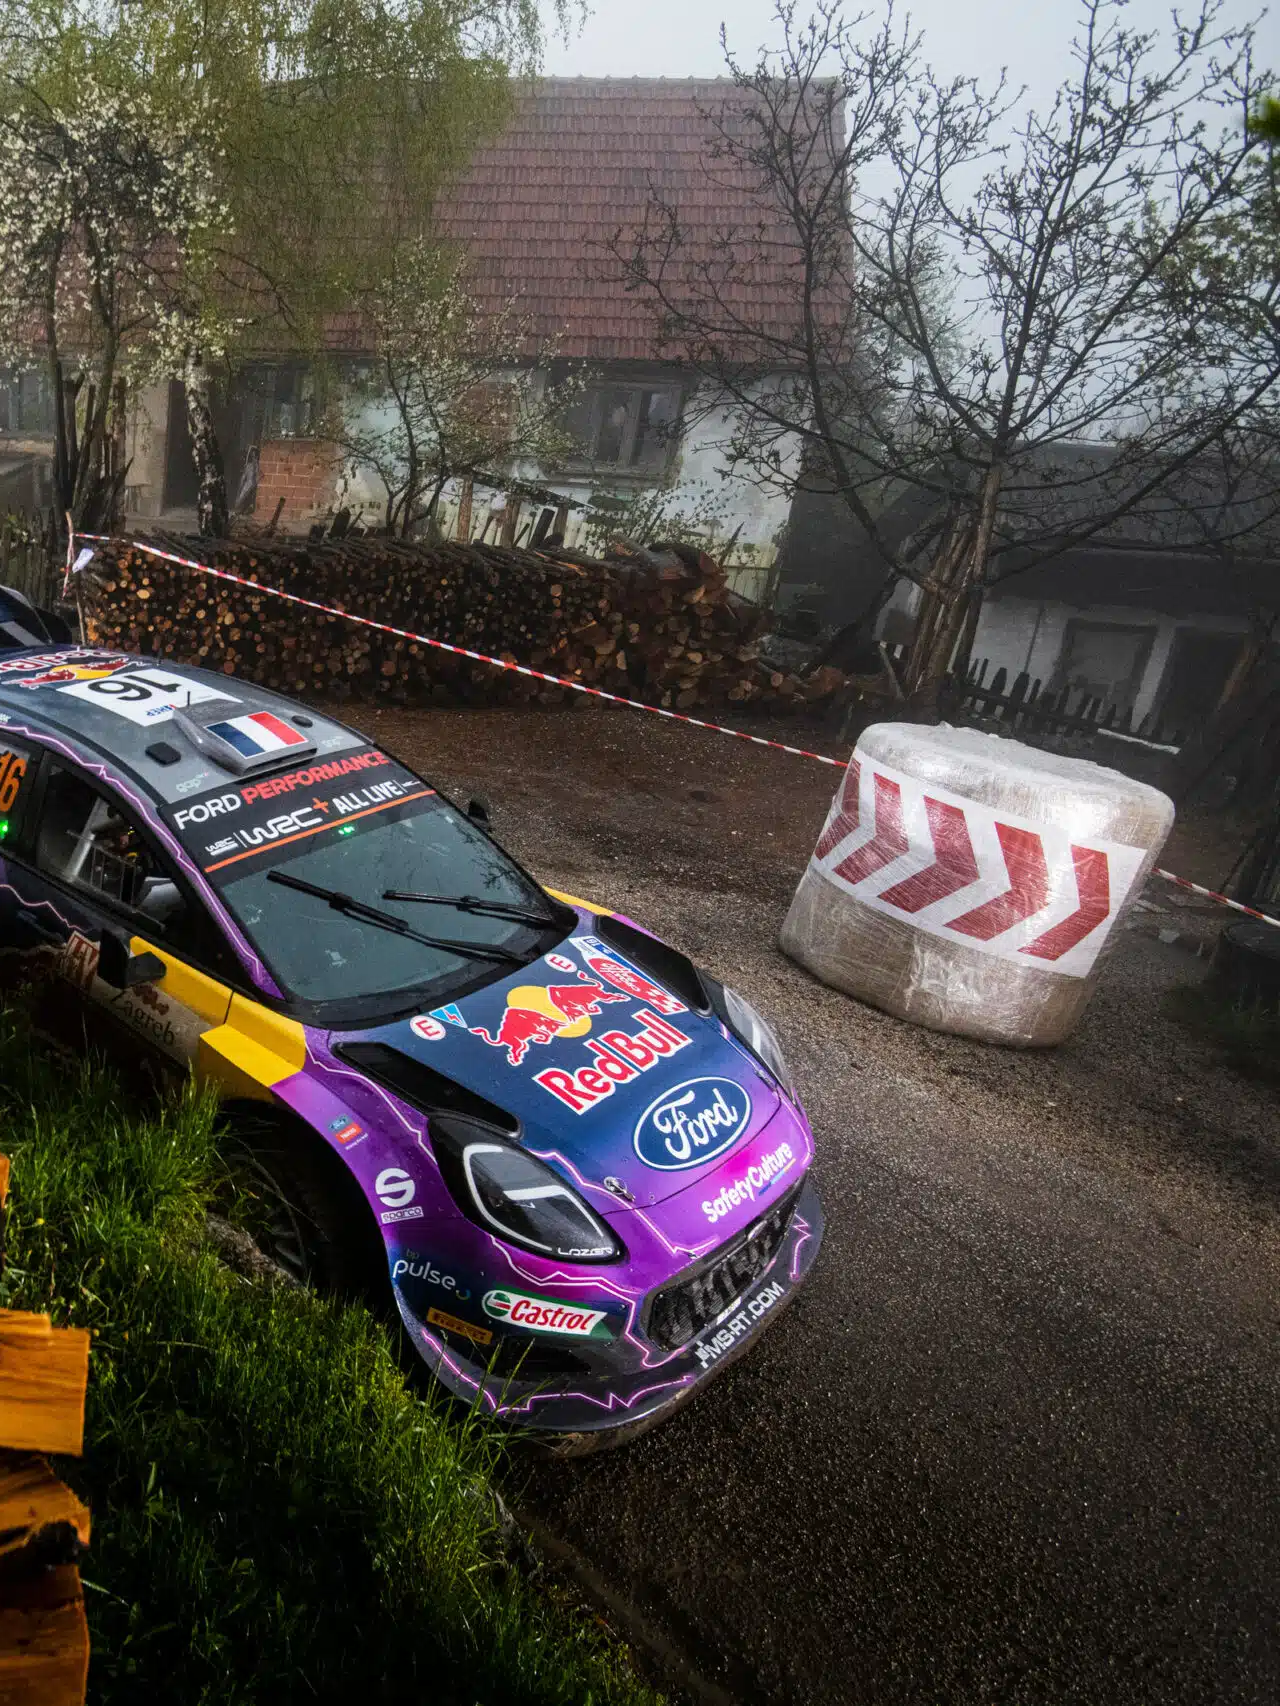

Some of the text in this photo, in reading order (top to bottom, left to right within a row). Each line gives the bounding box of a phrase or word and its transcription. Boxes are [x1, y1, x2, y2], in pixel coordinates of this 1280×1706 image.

[87, 674, 183, 701] 16
[173, 751, 390, 830] FORD PERFORMANCE
[332, 792, 362, 815] ALL
[362, 780, 404, 803] LIVE
[111, 988, 175, 1046] Zagreb
[416, 1019, 441, 1038] E
[653, 1088, 739, 1160] Ford
[701, 1141, 794, 1223] SafetyCulture
[383, 1207, 423, 1222] sparco
[392, 1260, 457, 1290] pulse
[510, 1299, 596, 1331] Castrol
